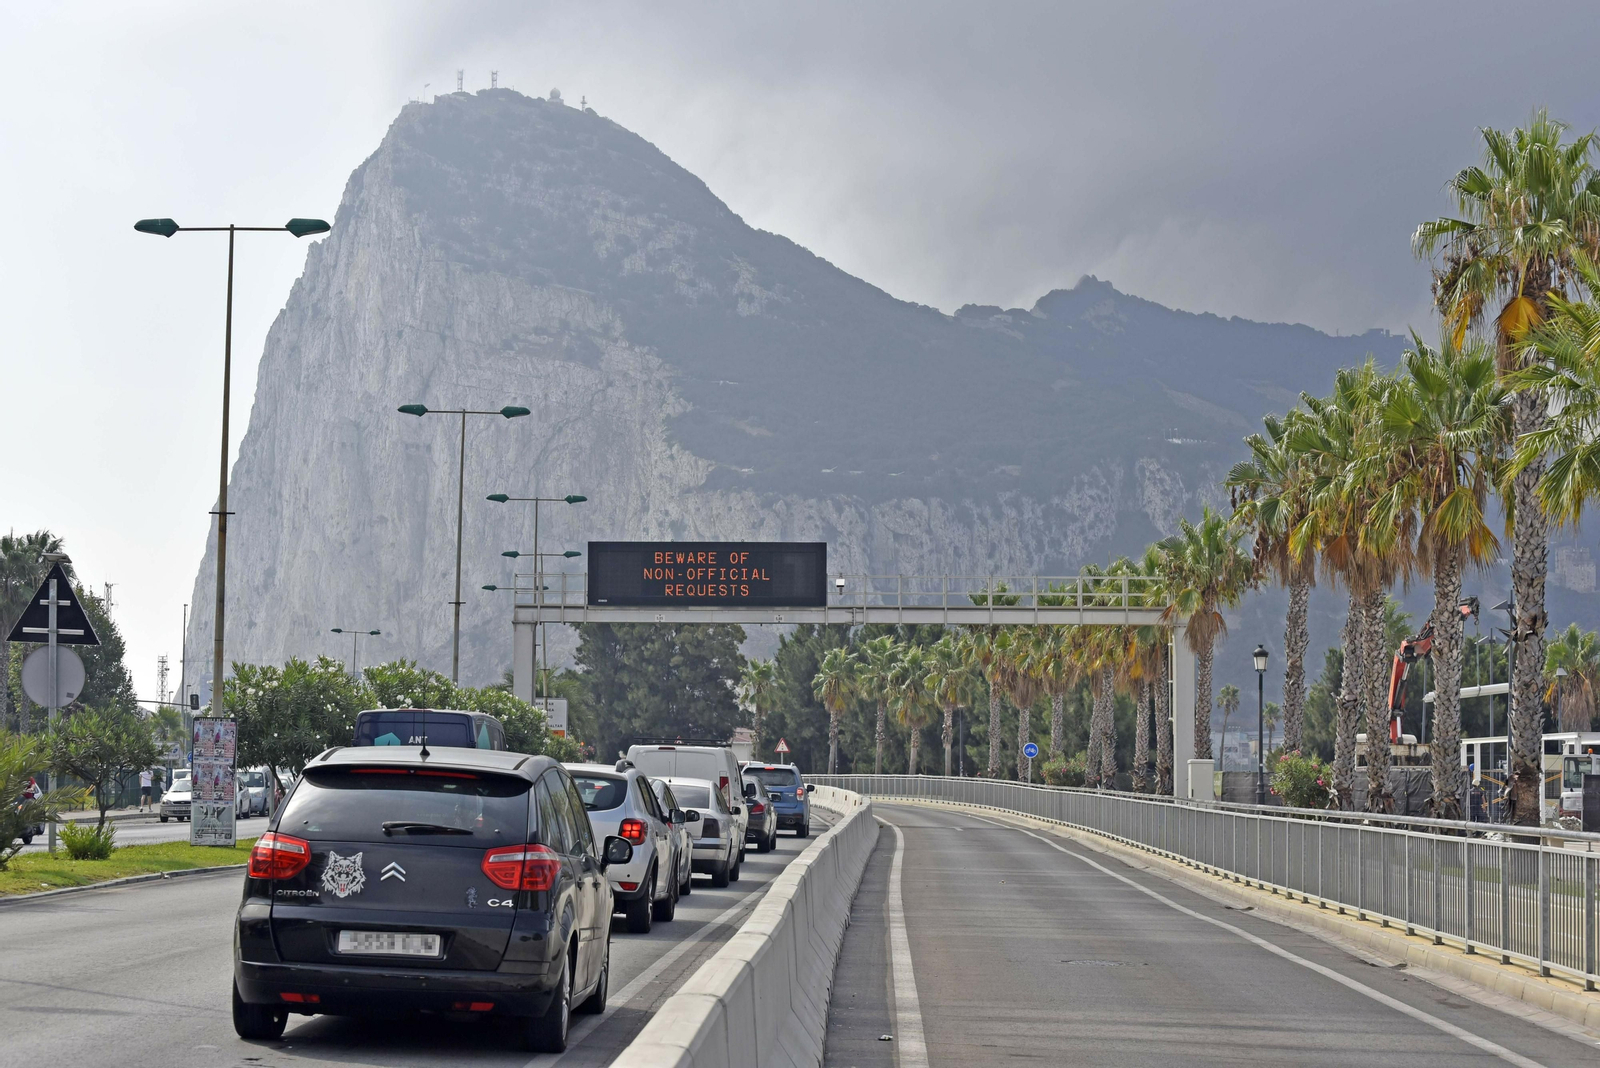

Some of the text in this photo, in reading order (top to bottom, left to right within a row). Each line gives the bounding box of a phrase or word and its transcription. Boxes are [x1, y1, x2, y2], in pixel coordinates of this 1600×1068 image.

[654, 552, 750, 564] BEWARE OF
[643, 568, 770, 581] NON-OFFICIAL
[664, 584, 750, 597] REQUESTS
[276, 889, 320, 897] CITROËN
[486, 898, 514, 908] C4
